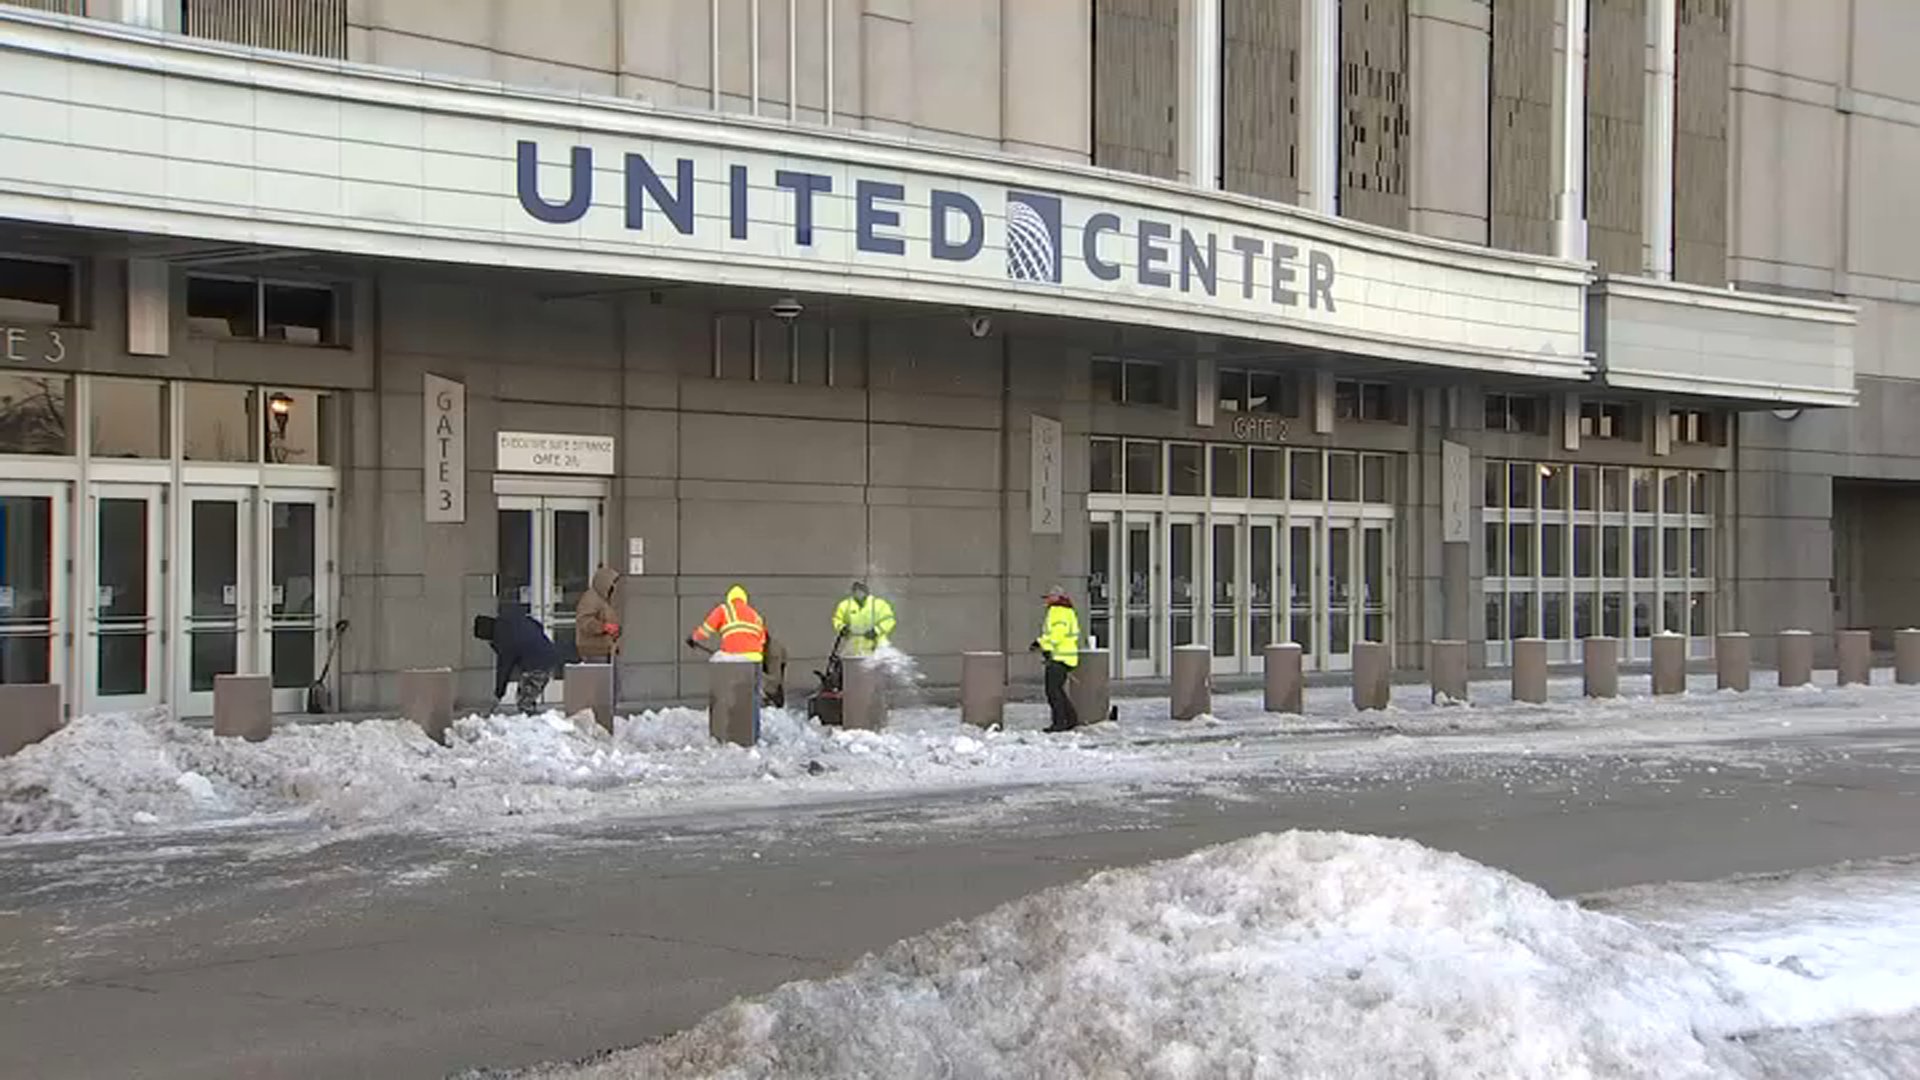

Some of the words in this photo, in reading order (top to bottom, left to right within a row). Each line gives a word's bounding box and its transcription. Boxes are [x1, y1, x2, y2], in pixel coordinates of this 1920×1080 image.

[516, 140, 985, 261] UNITED
[1083, 212, 1337, 313] CENTER
[44, 330, 65, 362] 3
[436, 391, 453, 482] GATE
[1233, 417, 1273, 440] GATE
[1279, 420, 1289, 441] 2
[439, 489, 452, 511] 3
[1042, 507, 1052, 525] 2
